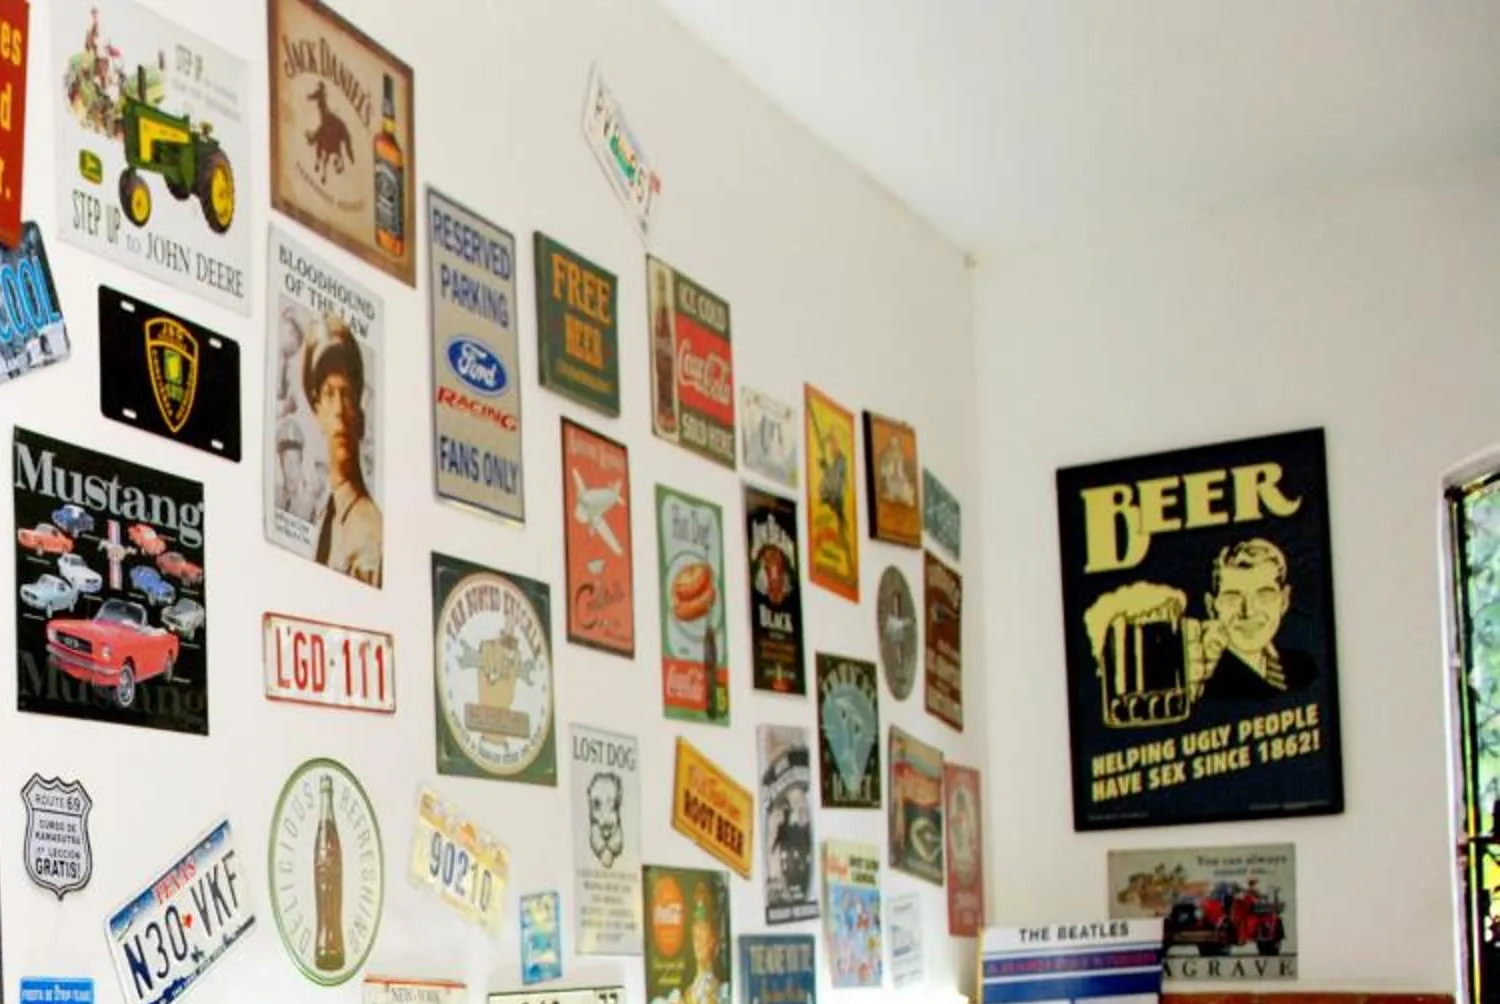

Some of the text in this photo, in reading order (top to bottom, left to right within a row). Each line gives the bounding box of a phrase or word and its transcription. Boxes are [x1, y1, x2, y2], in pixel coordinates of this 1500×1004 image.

[72, 189, 102, 233] STEP
[106, 205, 122, 242] UP
[145, 234, 192, 276] JOHN
[196, 252, 245, 299] DEERE
[432, 208, 512, 281] RESERVED
[279, 245, 376, 321] BLOODHOUND
[285, 273, 370, 340] OF THE LAW
[439, 263, 510, 330] PARKING
[551, 253, 613, 327] FREE
[455, 342, 498, 388] Ford
[436, 385, 518, 432] RACING
[14, 441, 203, 548] Mustang
[439, 434, 479, 483] FANS
[483, 451, 519, 496] ONLY
[1080, 461, 1303, 575] BEER
[759, 603, 793, 634] BLACK
[572, 734, 606, 766] LOST
[607, 745, 637, 772] DOG
[1091, 728, 1321, 804] HAVE SEX SINCE 1862!
[1092, 703, 1320, 779] HELPING UGLY PEOPLE
[429, 830, 493, 914] 90210
[1019, 921, 1130, 943] THE BEATLES
